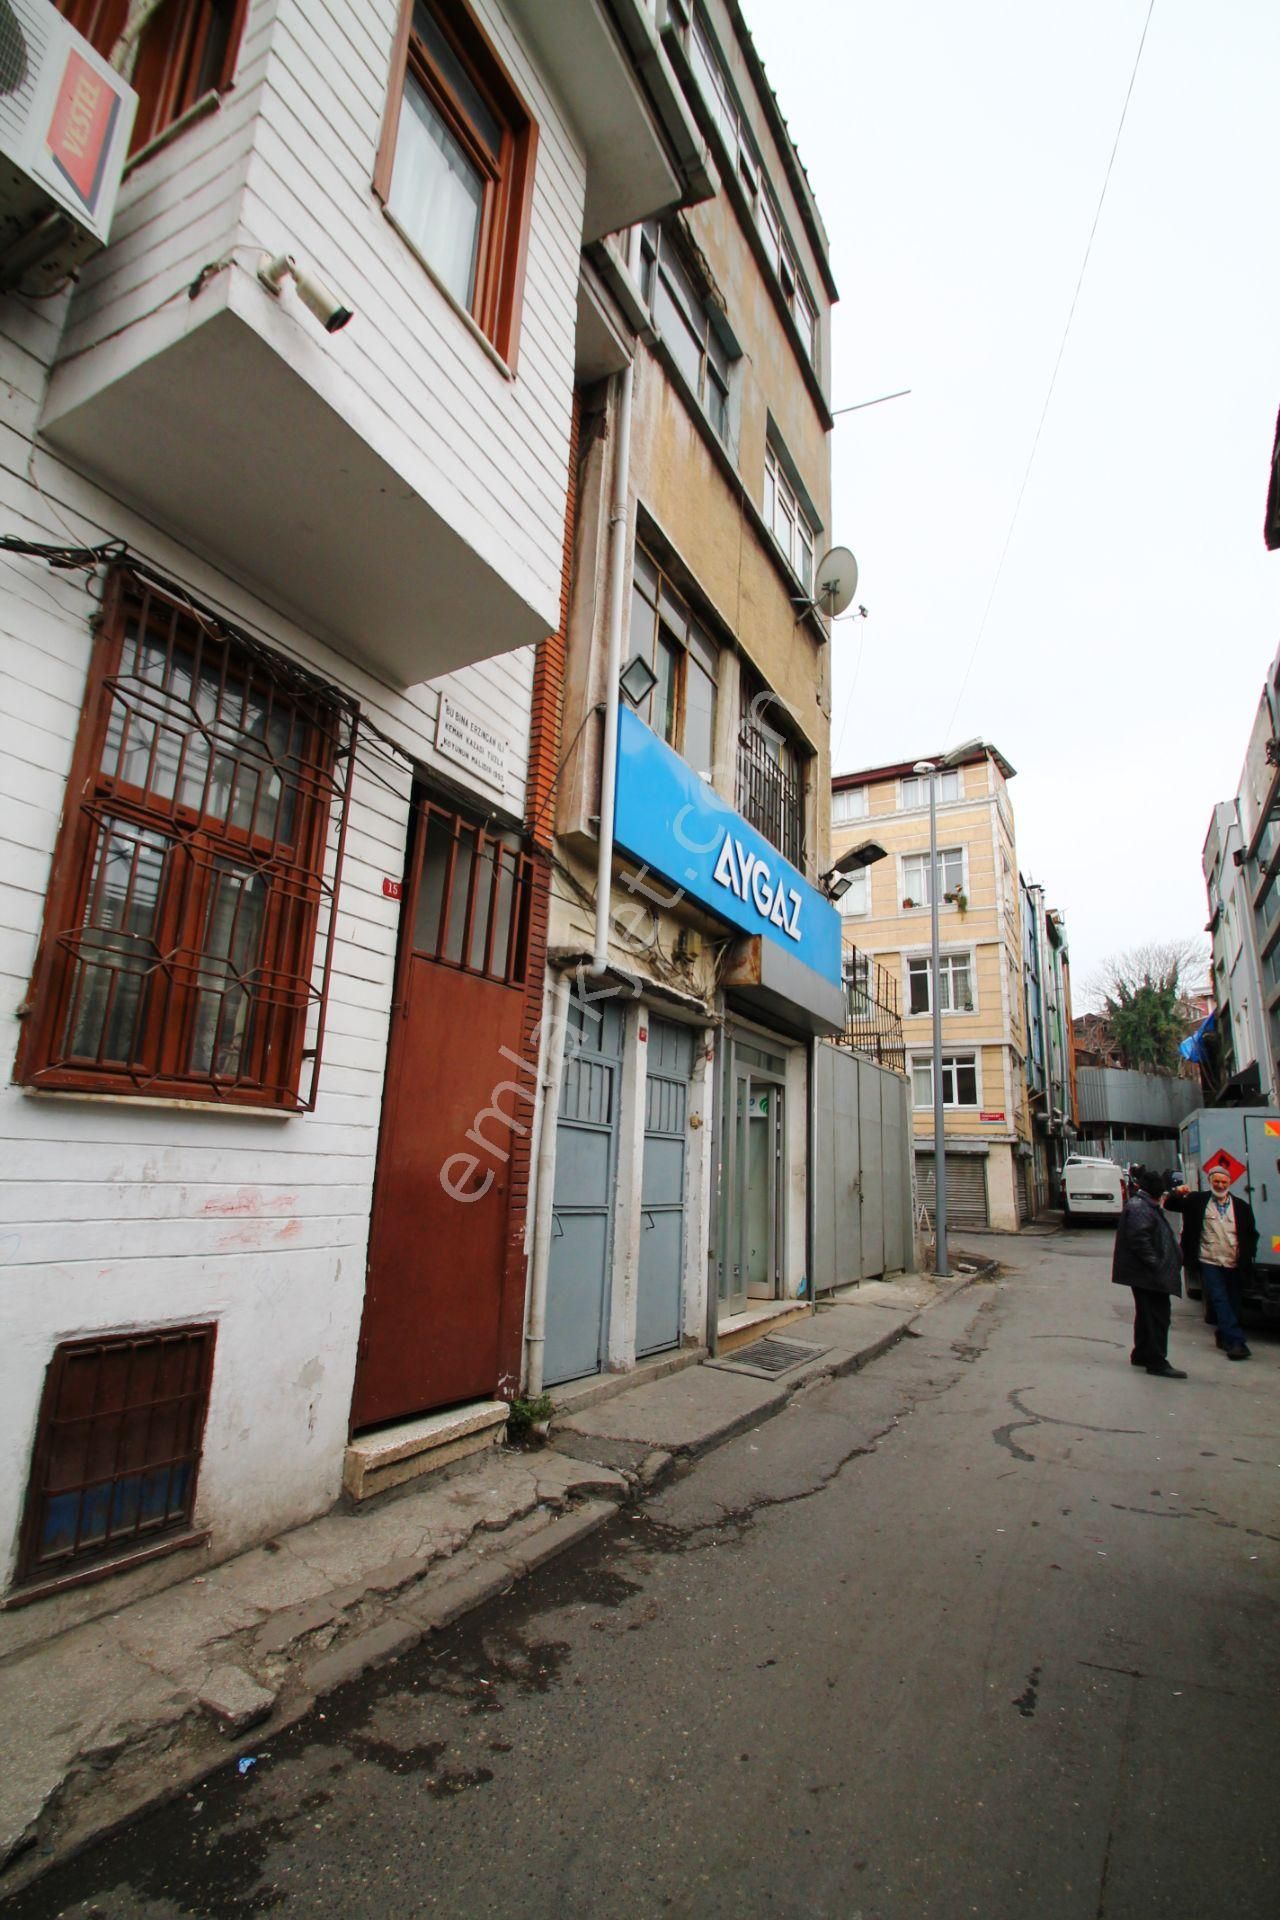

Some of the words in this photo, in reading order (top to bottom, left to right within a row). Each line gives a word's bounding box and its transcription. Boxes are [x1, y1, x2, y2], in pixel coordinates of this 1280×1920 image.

[62, 74, 100, 158] VESTEL
[446, 705, 454, 718] BU
[388, 882, 398, 895] 15
[713, 831, 803, 942] AYGAZ
